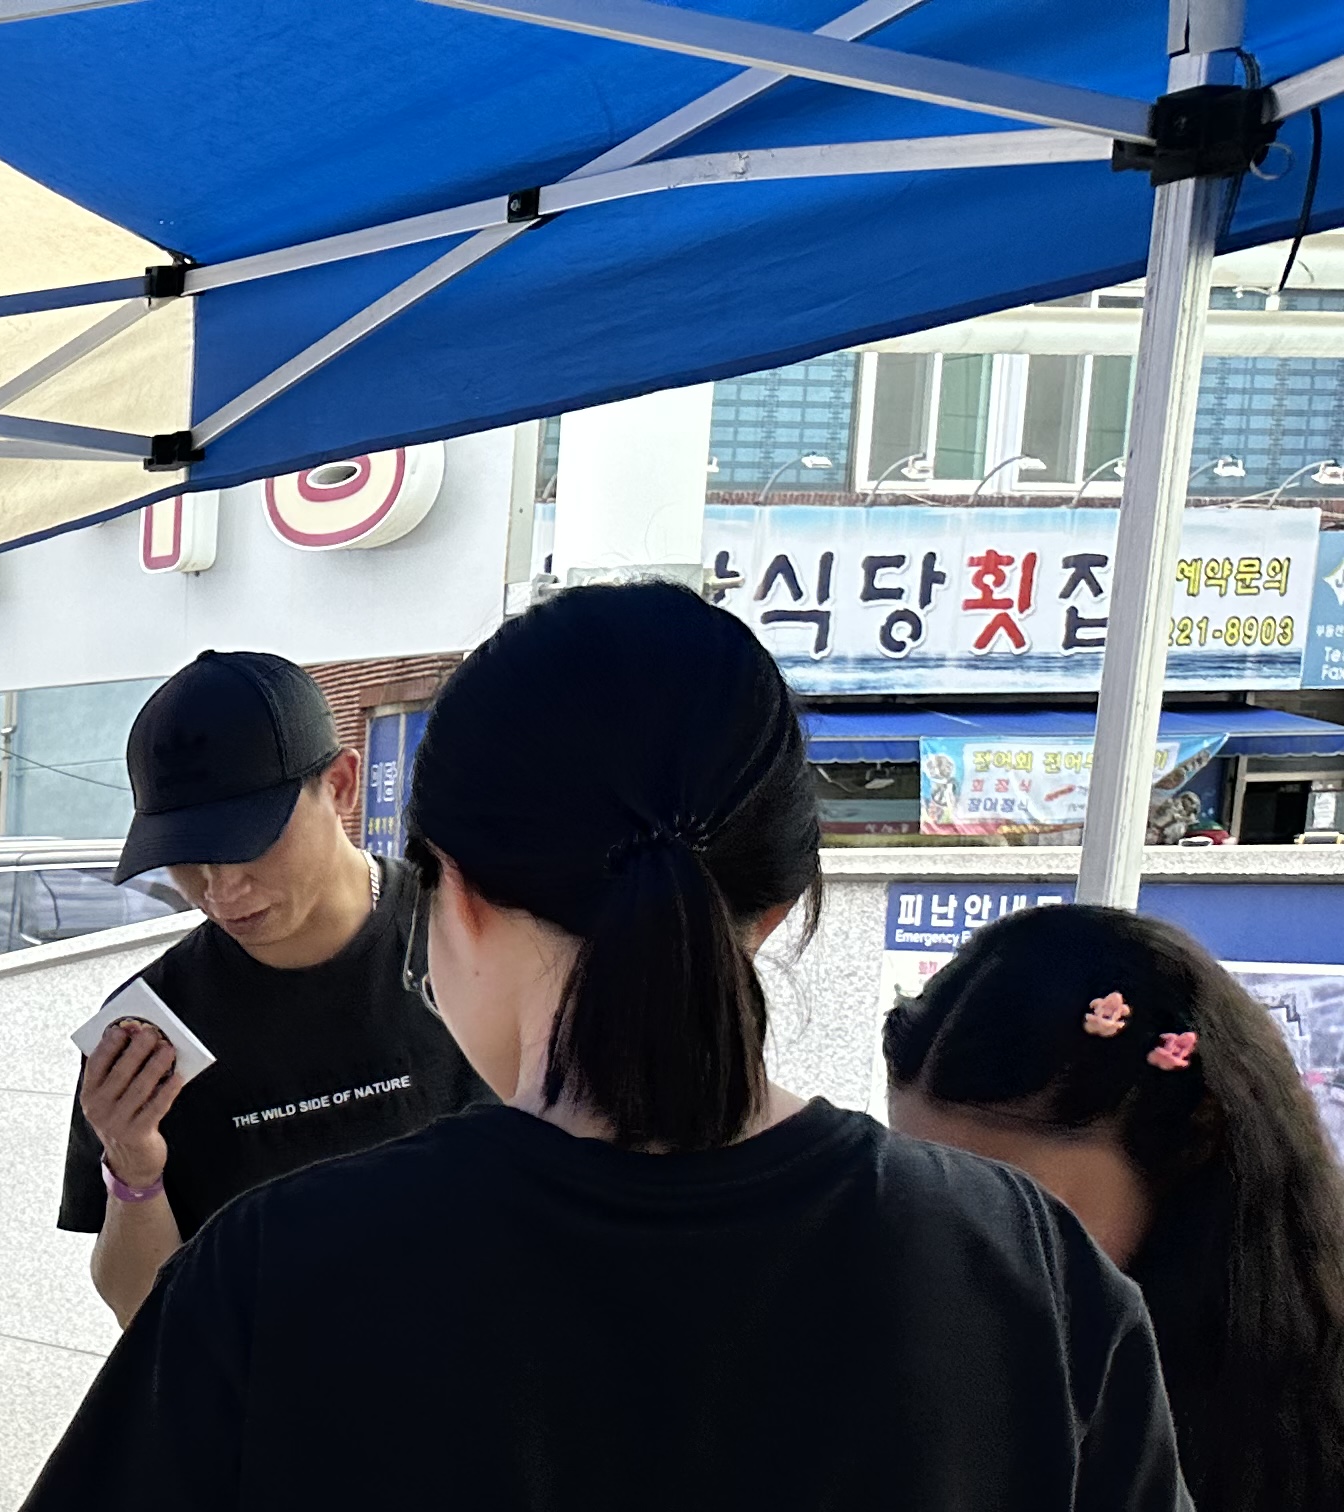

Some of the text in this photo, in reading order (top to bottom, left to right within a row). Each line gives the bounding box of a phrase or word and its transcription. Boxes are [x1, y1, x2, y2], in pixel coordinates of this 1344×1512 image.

[1176, 557, 1291, 598] 예약문의
[895, 928, 960, 946] Emergency
[232, 1075, 411, 1128] THE WILD SIDE OF NATURE
